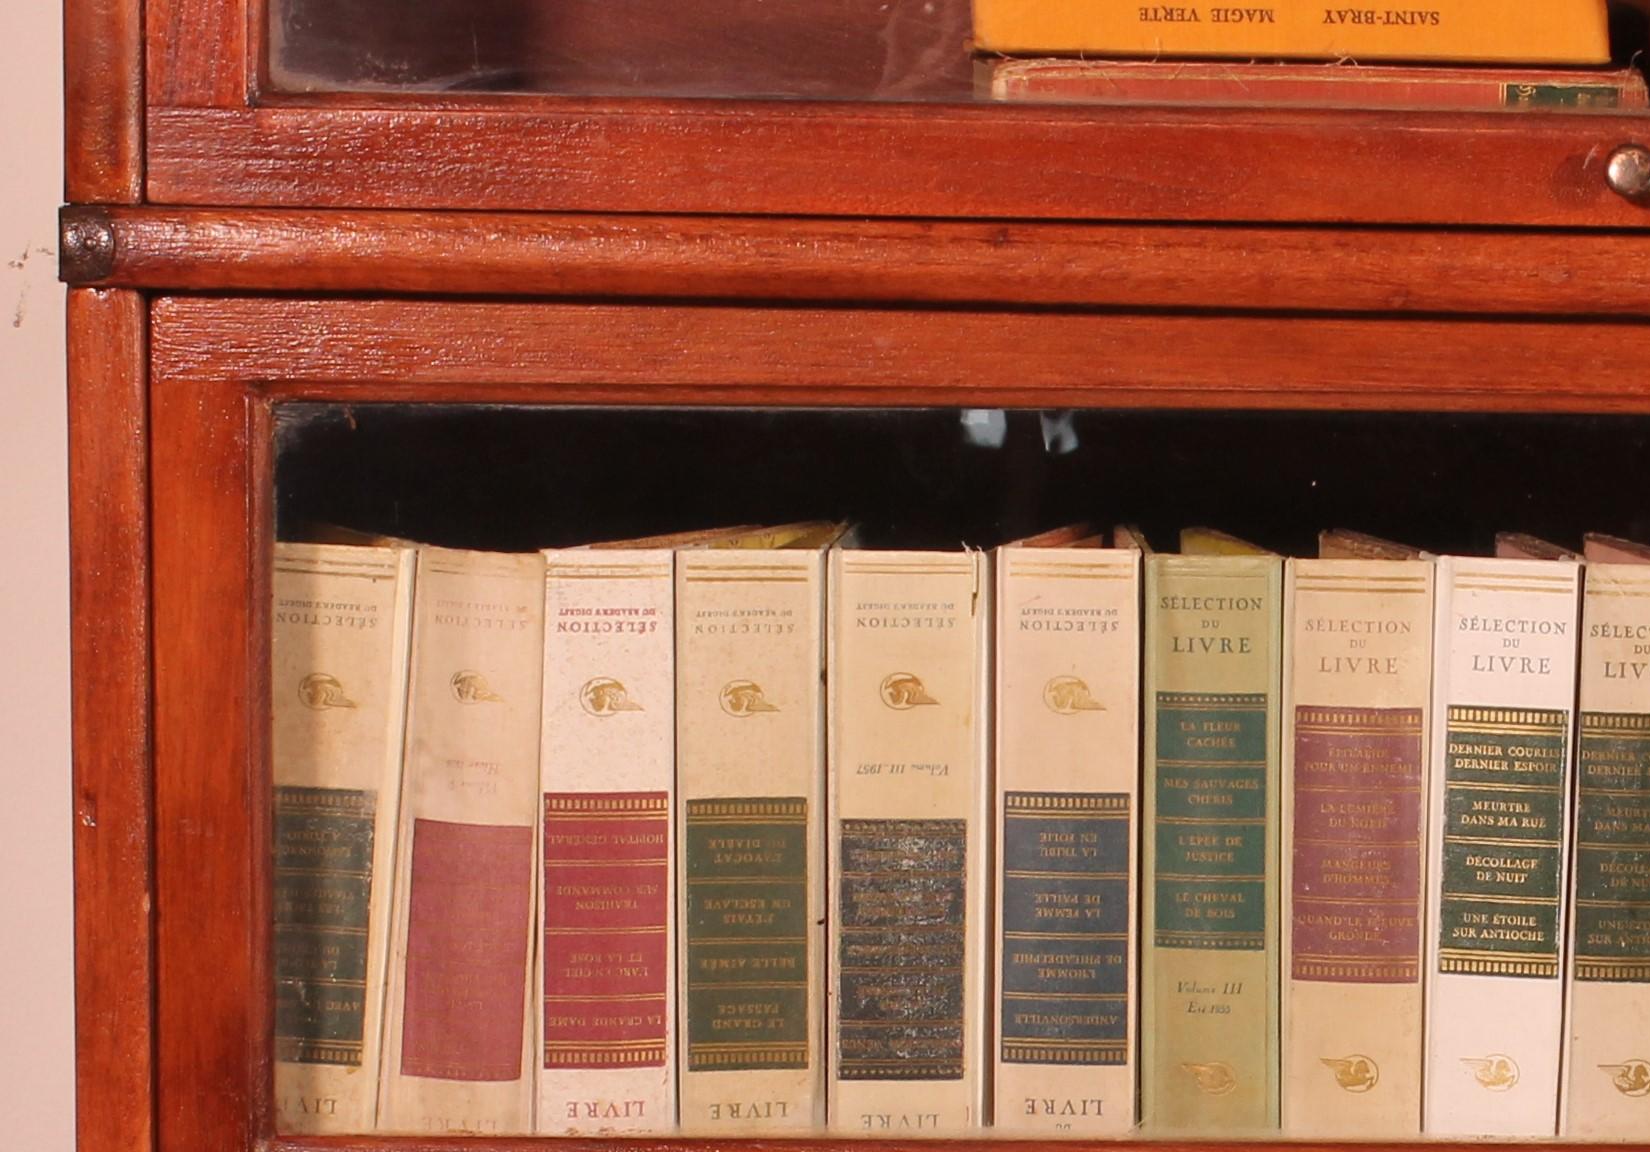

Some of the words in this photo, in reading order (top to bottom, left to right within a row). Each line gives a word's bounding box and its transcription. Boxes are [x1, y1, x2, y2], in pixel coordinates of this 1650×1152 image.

[1138, 6, 1201, 23] VERTE
[1210, 8, 1275, 23] MAGIE
[1322, 10, 1441, 26] SAINT-BRAY
[939, 602, 956, 613] DU
[1159, 595, 1263, 611] SÉLECTION
[557, 607, 593, 618] DIGEST
[595, 607, 640, 618] READER'S
[641, 608, 656, 617] DU
[1020, 607, 1055, 618] DIGEST
[1057, 607, 1102, 618] READER'S
[1105, 608, 1119, 617] DU
[556, 620, 657, 636] SÉLECTION
[694, 623, 796, 636] SÉLECTION
[856, 616, 957, 631] SÉLECTION
[1018, 620, 1120, 636] SÉLECTION
[1200, 618, 1222, 630] DU
[1305, 616, 1413, 634] SÉLECTION
[1458, 615, 1567, 635] SÉLECTION
[1172, 636, 1252, 655] LIVRE
[1349, 639, 1367, 649] DU
[1501, 637, 1521, 649] DU
[1319, 656, 1399, 675] LIVRE
[1471, 654, 1552, 675] LIVRE
[1202, 720, 1242, 733] FLEUR
[1448, 743, 1504, 756] DERNIER
[1582, 749, 1636, 762] DERNIER
[1455, 758, 1510, 771] DERNIER
[1513, 760, 1559, 773] ESPOIR
[1587, 764, 1642, 777] DERNIER
[1193, 778, 1260, 790] SAUVAGES
[1471, 800, 1532, 814] MEURTRE
[1460, 814, 1495, 827] DANS
[1496, 816, 1519, 828] MA
[1520, 817, 1548, 830] RUE
[1593, 820, 1629, 833] DANS
[1038, 831, 1076, 843] FOLIE
[1080, 831, 1097, 844] EN
[1224, 836, 1244, 848] DE
[1039, 846, 1077, 859] TRIBU
[1082, 847, 1098, 859] LA
[1183, 851, 1235, 863] JUSTICE
[1475, 871, 1493, 882] DE
[1495, 872, 1529, 884] NUIT
[1033, 892, 1080, 905] PAILLE
[1083, 893, 1102, 905] DE
[1194, 892, 1247, 905] CHEVAL
[1034, 906, 1080, 919] FEMME
[1085, 907, 1101, 919] LA
[1205, 908, 1236, 920] BOIS
[1462, 912, 1489, 924] UNE
[1492, 912, 1537, 927] ÉTOILE
[1452, 926, 1478, 939] SUR
[1480, 928, 1546, 942] ANTIOCHE
[1586, 932, 1613, 946] SUR
[1011, 952, 1101, 965] PHILADELPHIE
[1104, 953, 1122, 965] DE
[1037, 967, 1097, 980] L'HOMME
[1222, 981, 1247, 995] III
[718, 1003, 780, 1016] PASSAGE
[549, 1015, 586, 1028] DAME
[592, 1015, 642, 1027] GRANDE
[647, 1015, 662, 1026] LA
[712, 1017, 763, 1030] GRAND
[767, 1017, 785, 1029] LE
[1013, 1013, 1119, 1026] ANDERSONVILLE
[564, 1100, 645, 1119] LIVRE
[707, 1100, 788, 1120] LIVRE
[1024, 1098, 1103, 1116] LIVRE
[858, 1112, 940, 1131] LIVRE
